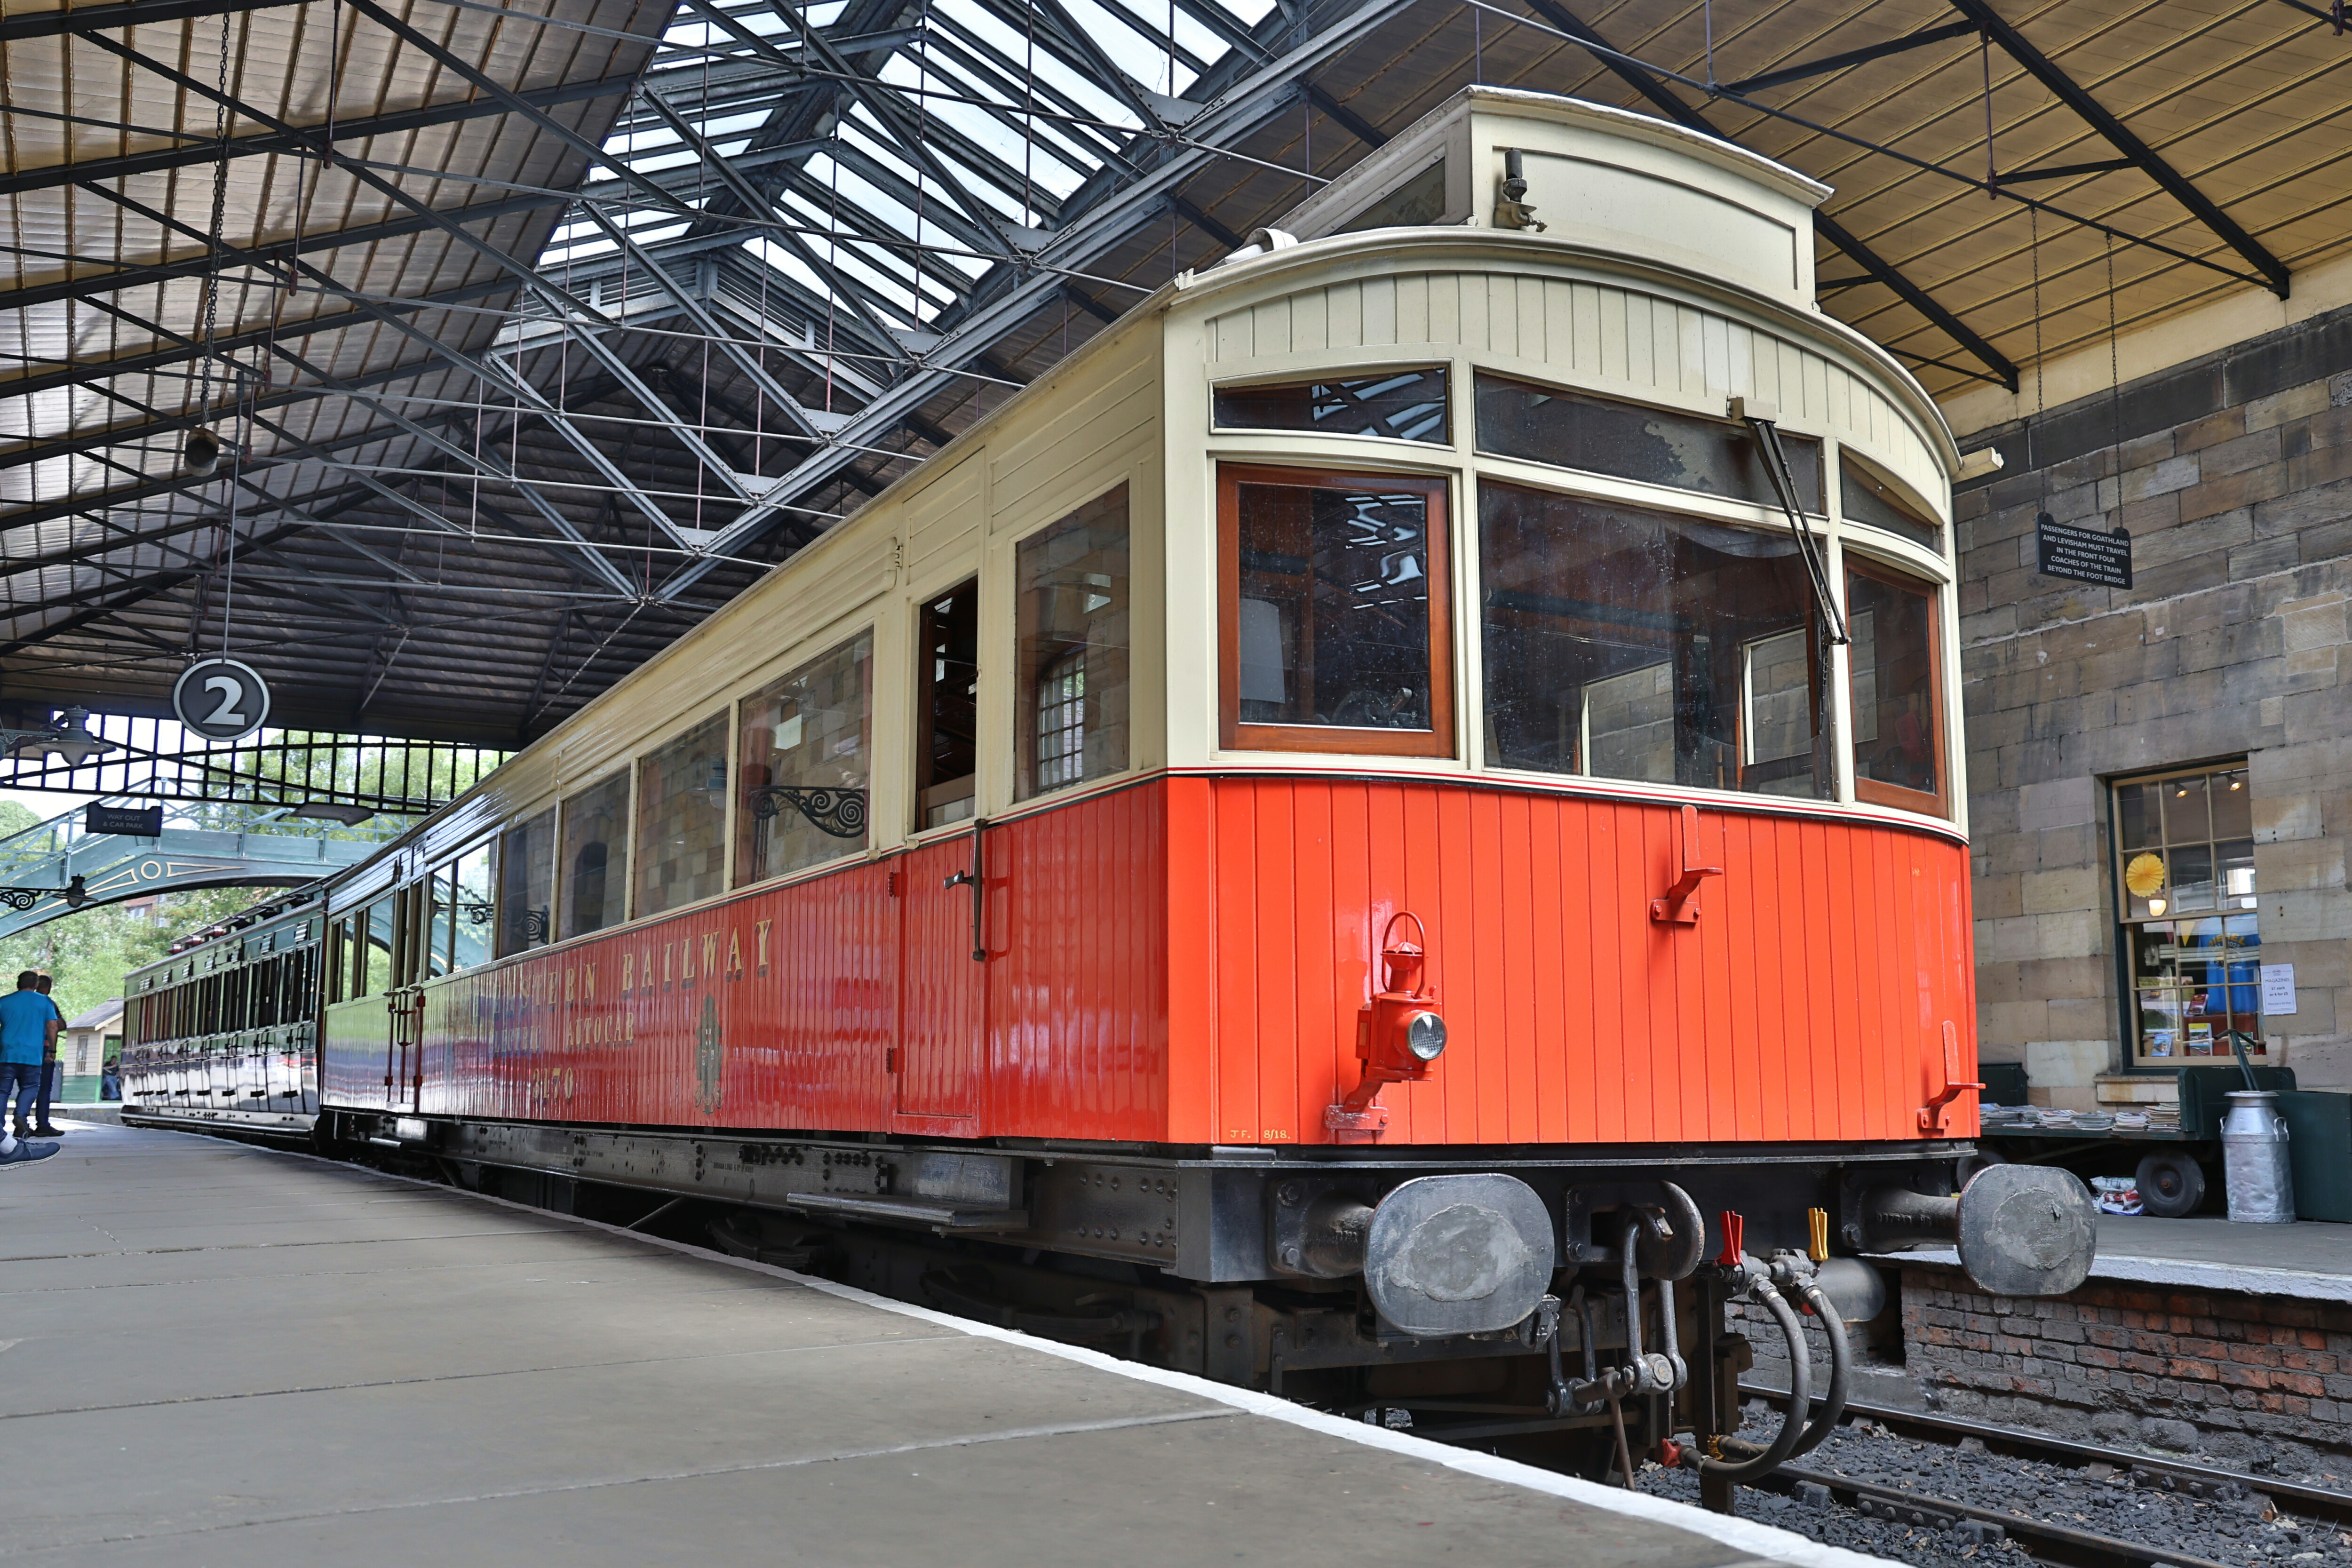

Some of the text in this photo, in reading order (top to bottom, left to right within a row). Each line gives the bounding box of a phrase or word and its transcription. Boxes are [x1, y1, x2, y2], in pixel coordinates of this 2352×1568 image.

[2041, 524, 2077, 537] PASSENGERS
[2092, 534, 2129, 546] GOATHLAND
[2058, 537, 2087, 549] LEVISHAM
[2088, 543, 2105, 552] MUST
[2106, 546, 2128, 556] TRAVEL
[2078, 551, 2098, 560] FRONT
[2099, 555, 2115, 563] FOUR
[2048, 565, 2072, 574] BEYOND
[2087, 572, 2103, 581] FOOT
[2104, 575, 2126, 585] BRIDGE
[2051, 556, 2079, 566] COACHES
[2103, 565, 2122, 574] TRAIN
[202, 676, 245, 725] 2
[622, 919, 772, 994] RAILWAY
[488, 1011, 635, 1054] ELECTRIC AUTOCAR
[532, 1067, 573, 1100] 3170
